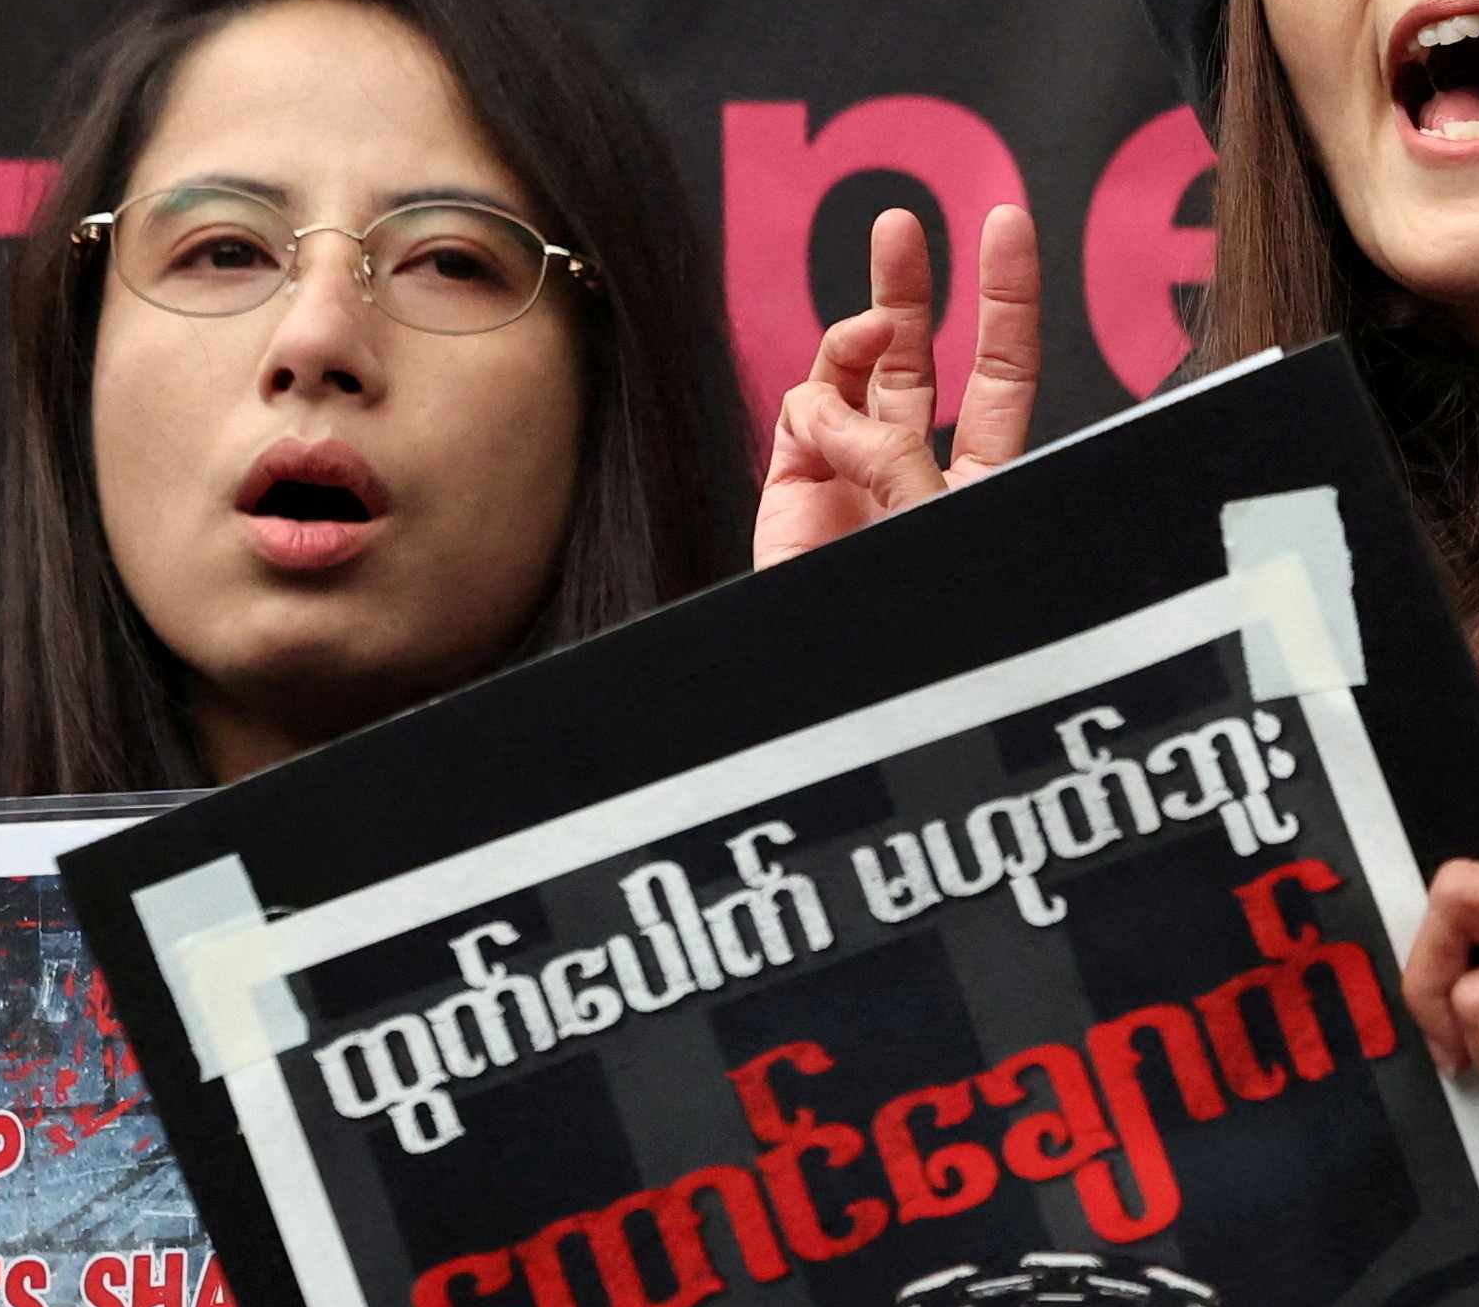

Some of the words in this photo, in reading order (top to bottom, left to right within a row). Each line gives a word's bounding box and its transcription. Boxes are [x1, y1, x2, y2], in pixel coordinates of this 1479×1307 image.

[314, 819, 834, 1155] ထွက်ပေါက်
[850, 705, 1298, 928] မဟုတ်ဘူး
